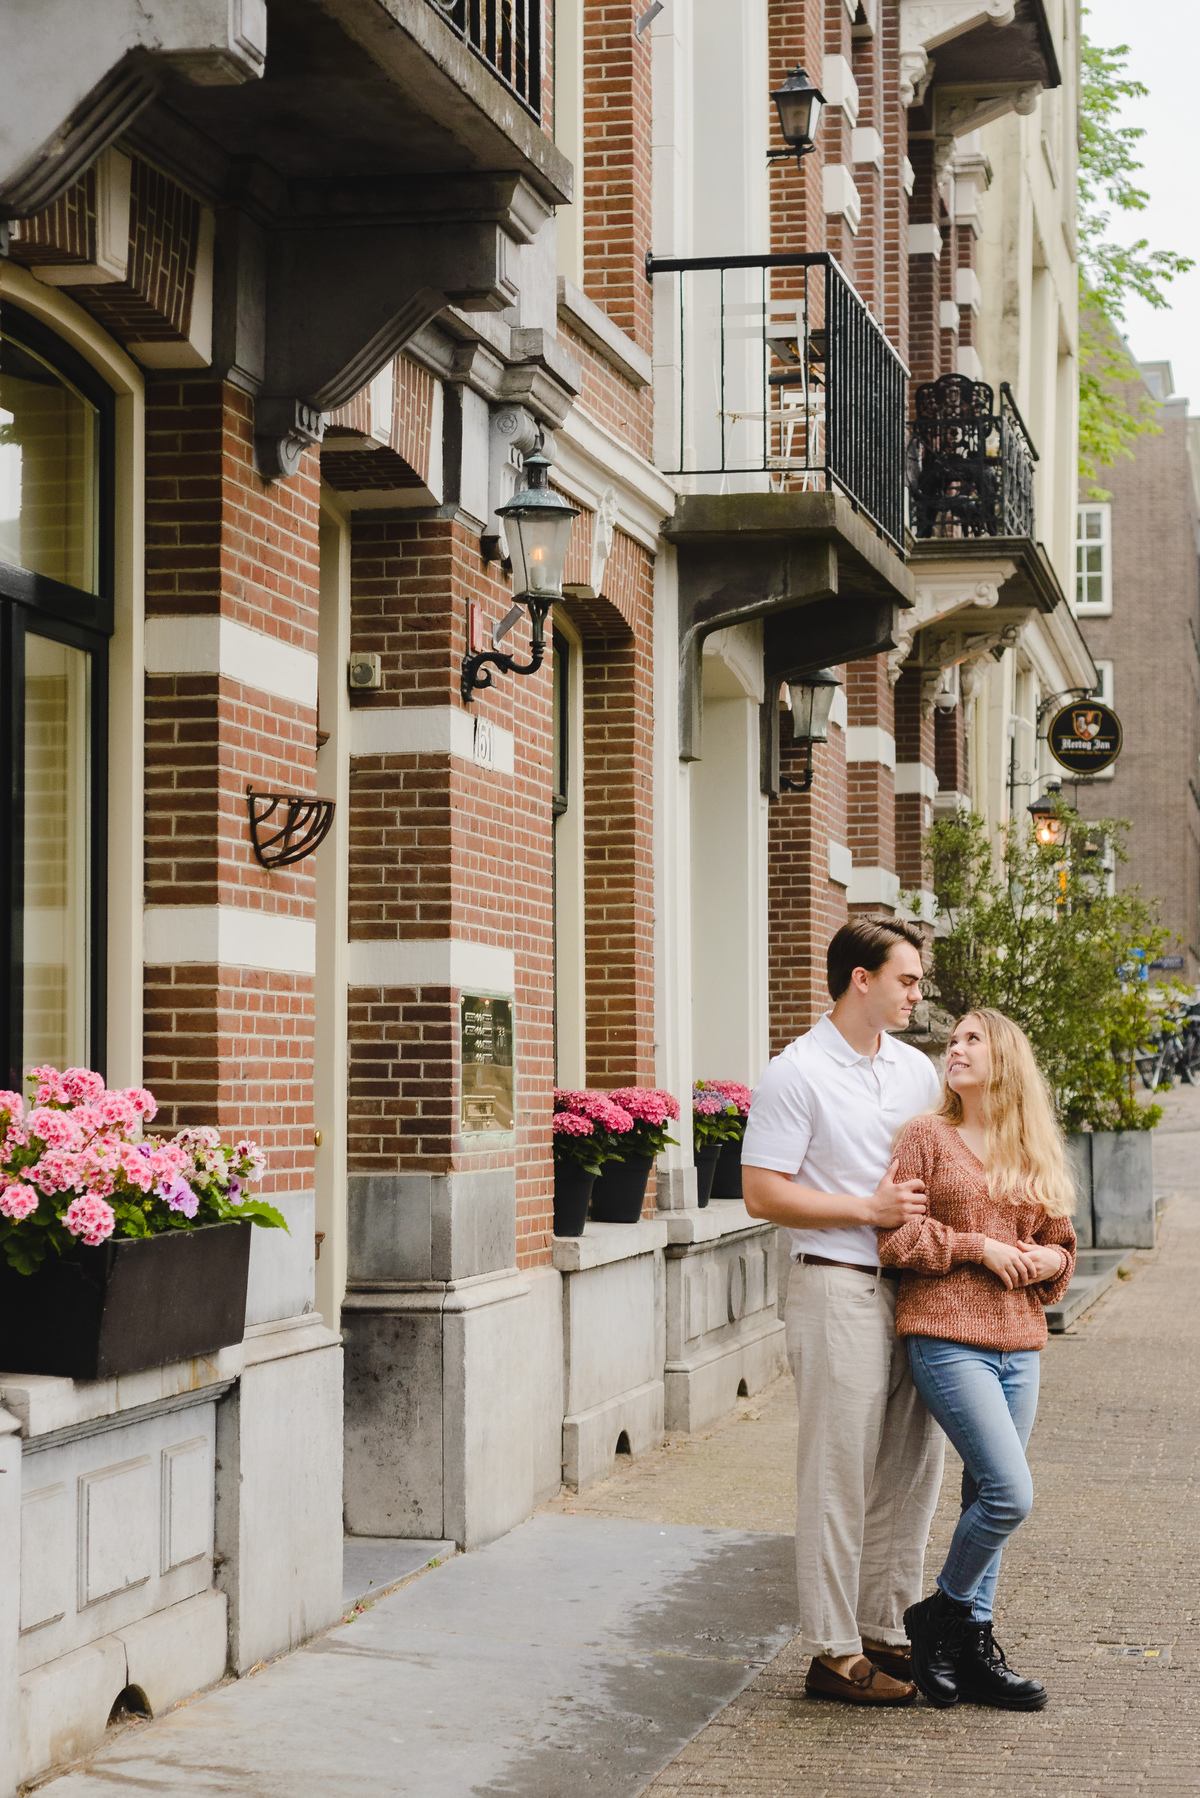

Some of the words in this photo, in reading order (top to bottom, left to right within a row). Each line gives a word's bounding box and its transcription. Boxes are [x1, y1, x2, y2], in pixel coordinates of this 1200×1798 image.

[477, 724, 492, 762] 151
[1061, 738, 1092, 750] Hertog
[1093, 738, 1110, 750] Jan
